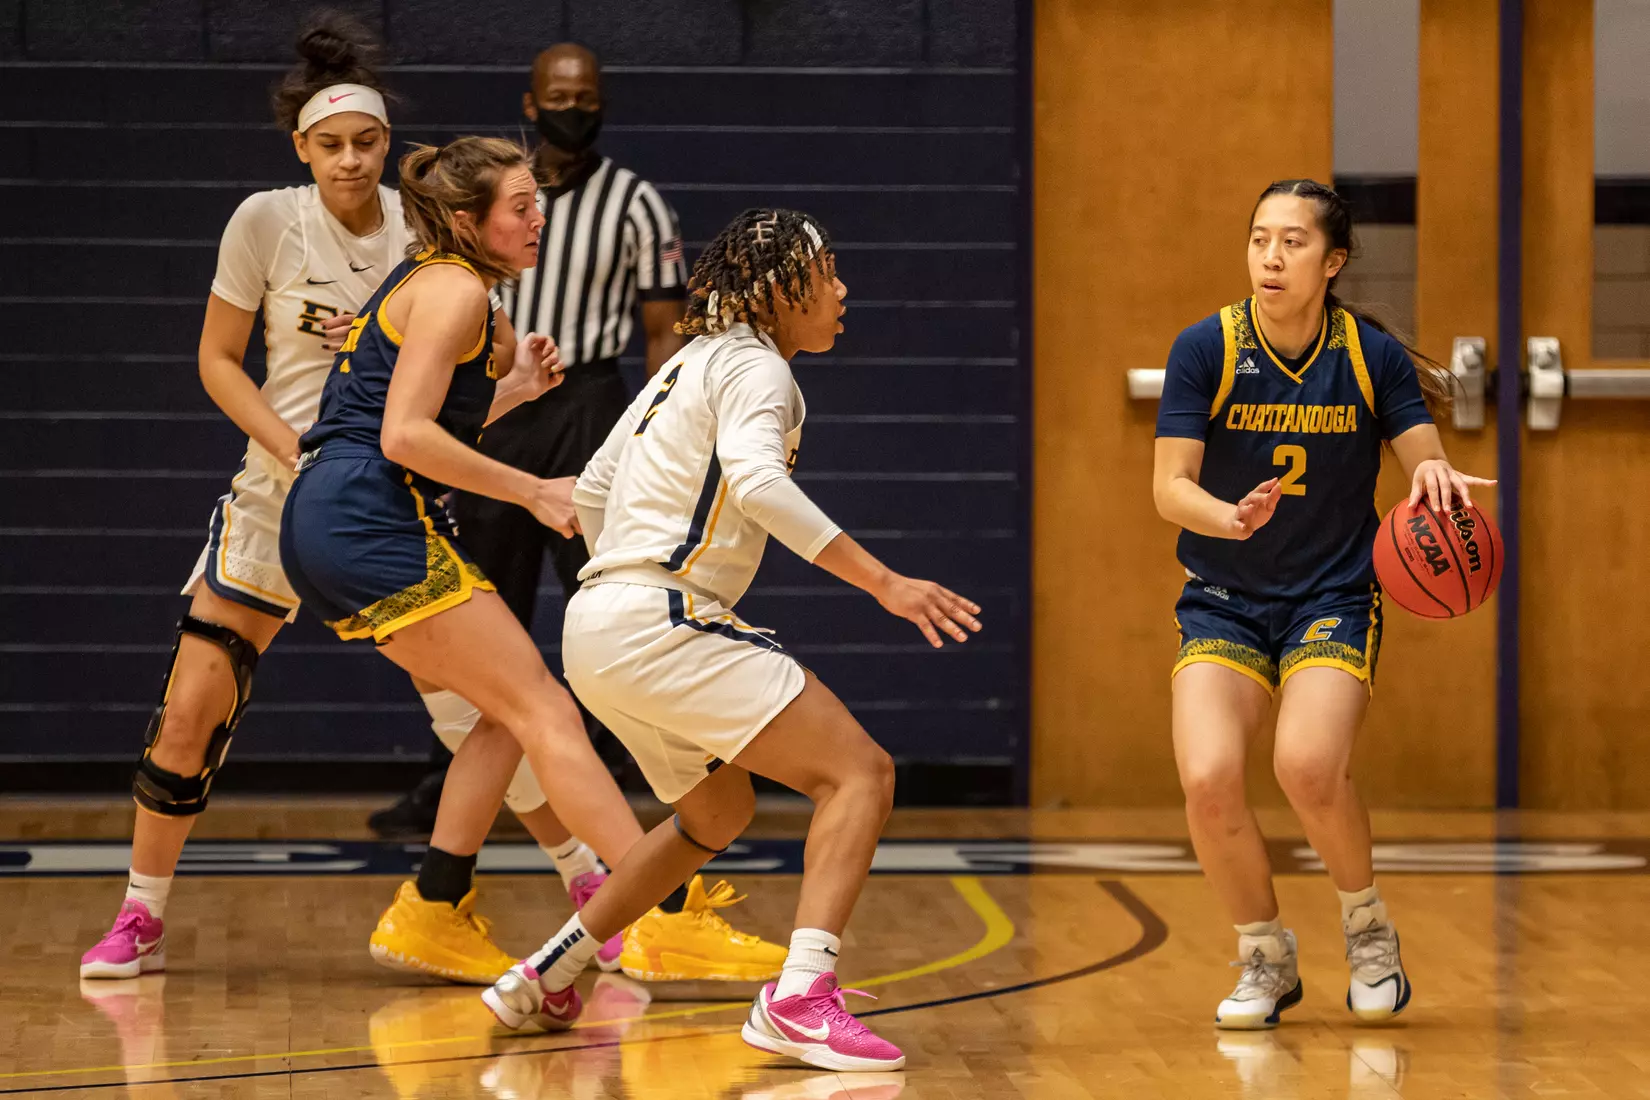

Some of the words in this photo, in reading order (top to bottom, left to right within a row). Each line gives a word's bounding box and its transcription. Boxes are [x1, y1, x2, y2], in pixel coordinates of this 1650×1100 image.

[1236, 366, 1260, 375] adidas
[634, 361, 684, 437] 2
[1225, 403, 1358, 434] CHATTANOOGA
[1272, 444, 1307, 496] 2
[1407, 514, 1451, 577] NCAA
[1203, 586, 1230, 601] adidas
